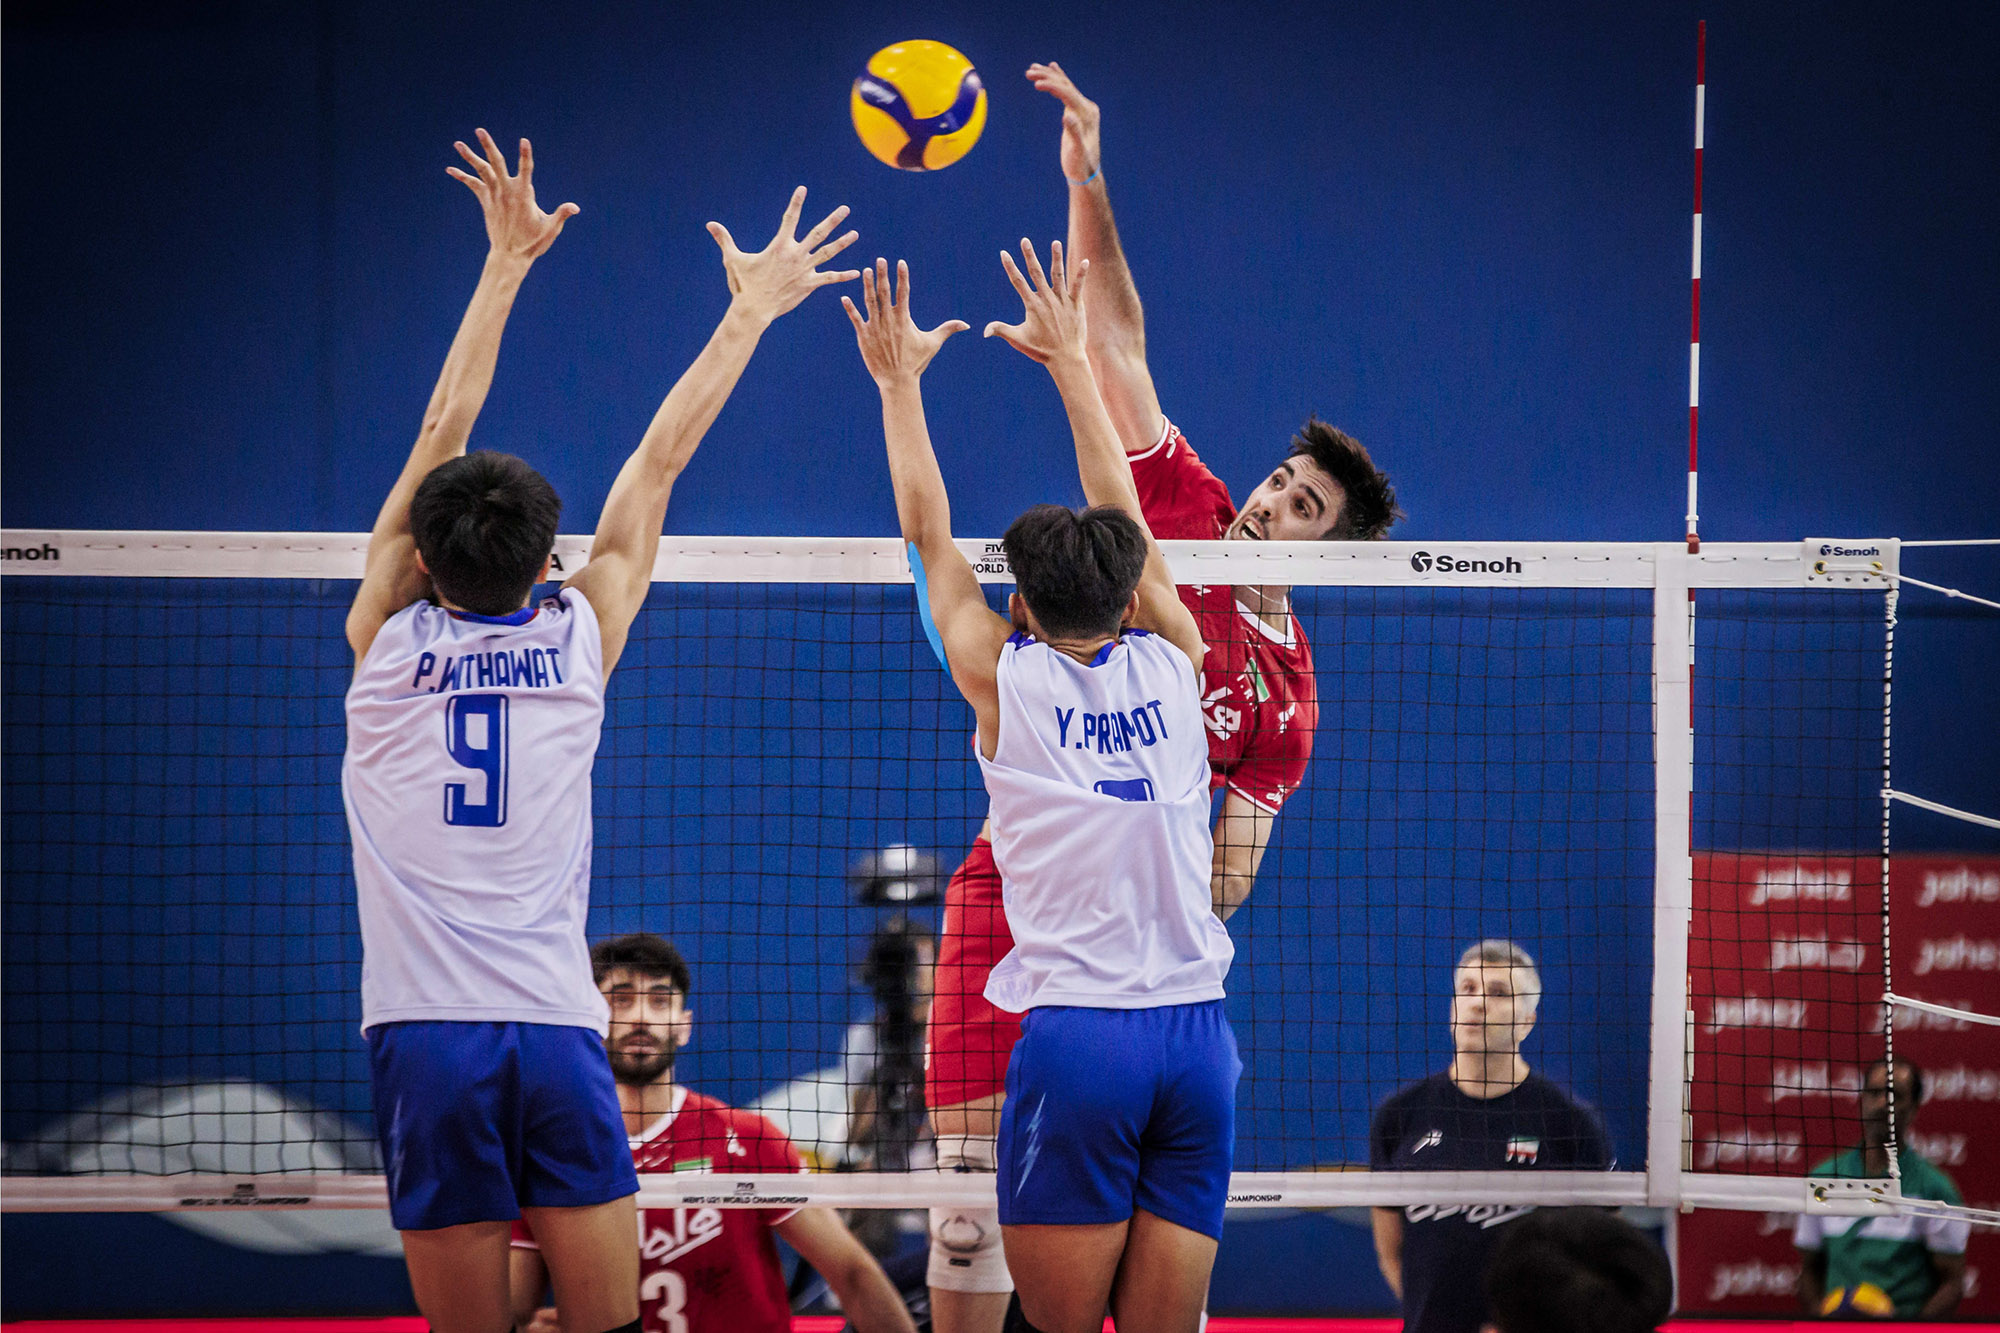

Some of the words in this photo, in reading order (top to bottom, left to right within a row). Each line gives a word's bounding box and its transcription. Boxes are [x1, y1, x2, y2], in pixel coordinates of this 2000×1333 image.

[1833, 546, 1880, 556] Senoh
[1435, 555, 1522, 574] Senoh
[1054, 699, 1169, 755] Y.PRAMOT
[444, 693, 510, 827] 9
[1227, 1194, 1283, 1203] CHAMPIONSHIP
